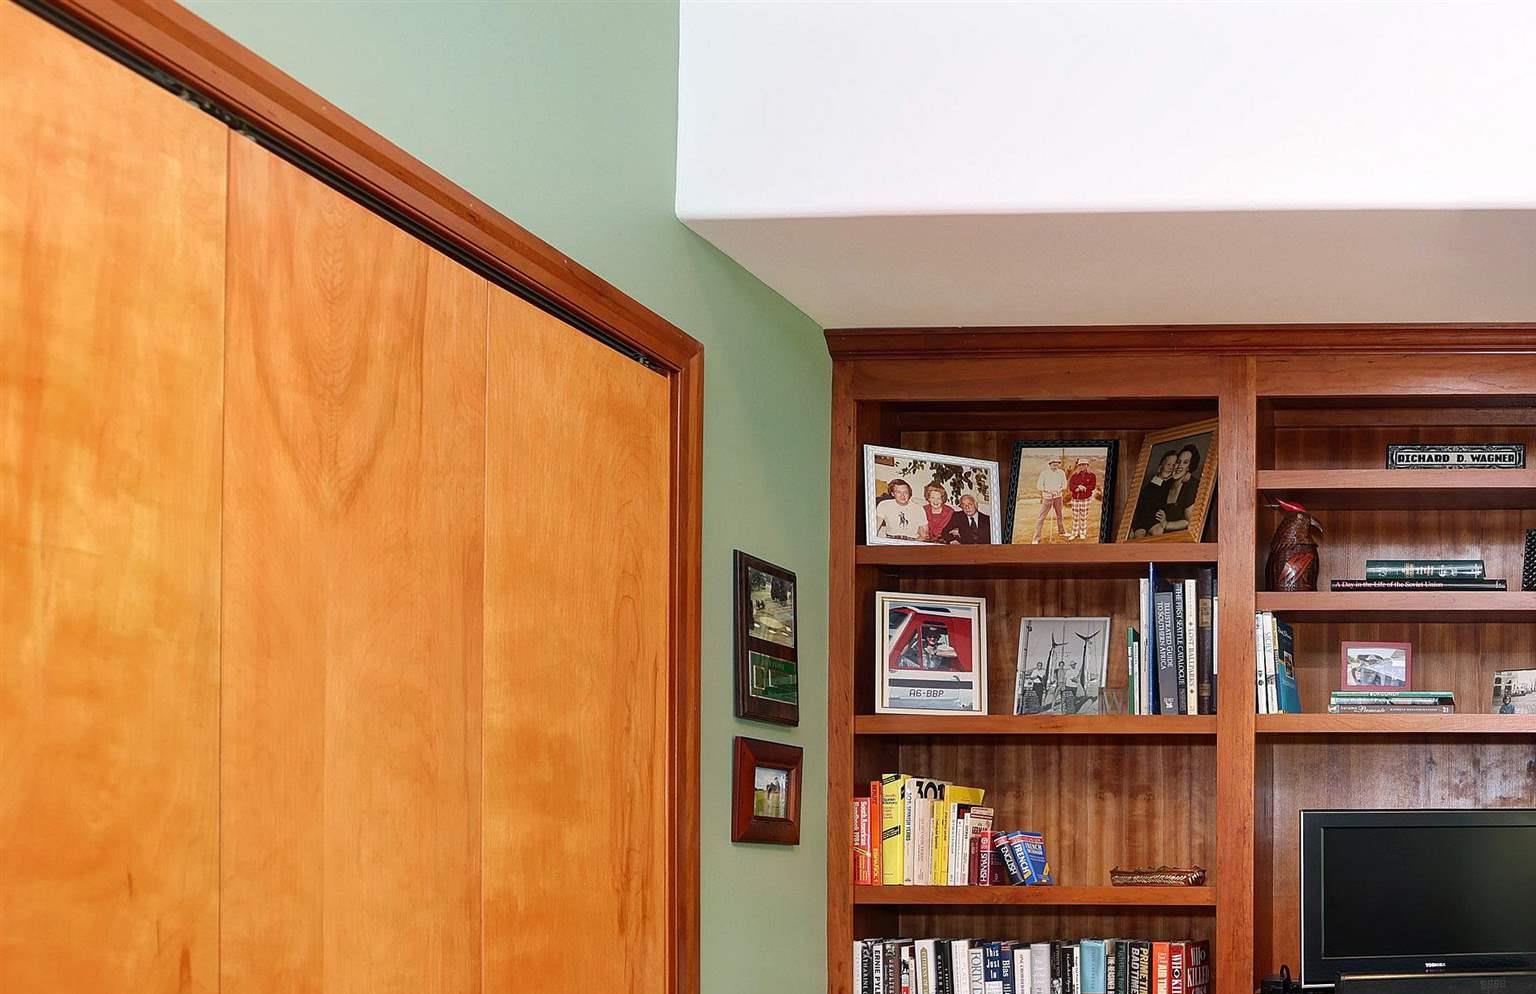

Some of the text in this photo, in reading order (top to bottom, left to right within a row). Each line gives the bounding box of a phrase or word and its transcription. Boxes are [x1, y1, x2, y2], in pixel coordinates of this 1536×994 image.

[1397, 454, 1515, 463] RICHARD D. WAGNER
[1175, 588, 1183, 601] THE
[1341, 581, 1354, 589] Day
[1157, 602, 1164, 611] TO
[1175, 601, 1183, 618] FIRST
[1157, 611, 1166, 646] SOUTHERN
[1164, 602, 1174, 668] ILLUSTRATED GUIDE
[1177, 646, 1185, 685] CATALOGUE
[980, 853, 988, 882] SPANISH
[1001, 846, 1018, 875] ENGLISH
[1014, 844, 1031, 873] FRENCH
[986, 948, 999, 957] This
[986, 960, 999, 968] Just
[1131, 947, 1139, 971] BAD
[1140, 947, 1149, 979] PRIME
[970, 952, 982, 986] FORTY
[1002, 960, 1010, 977] Bias
